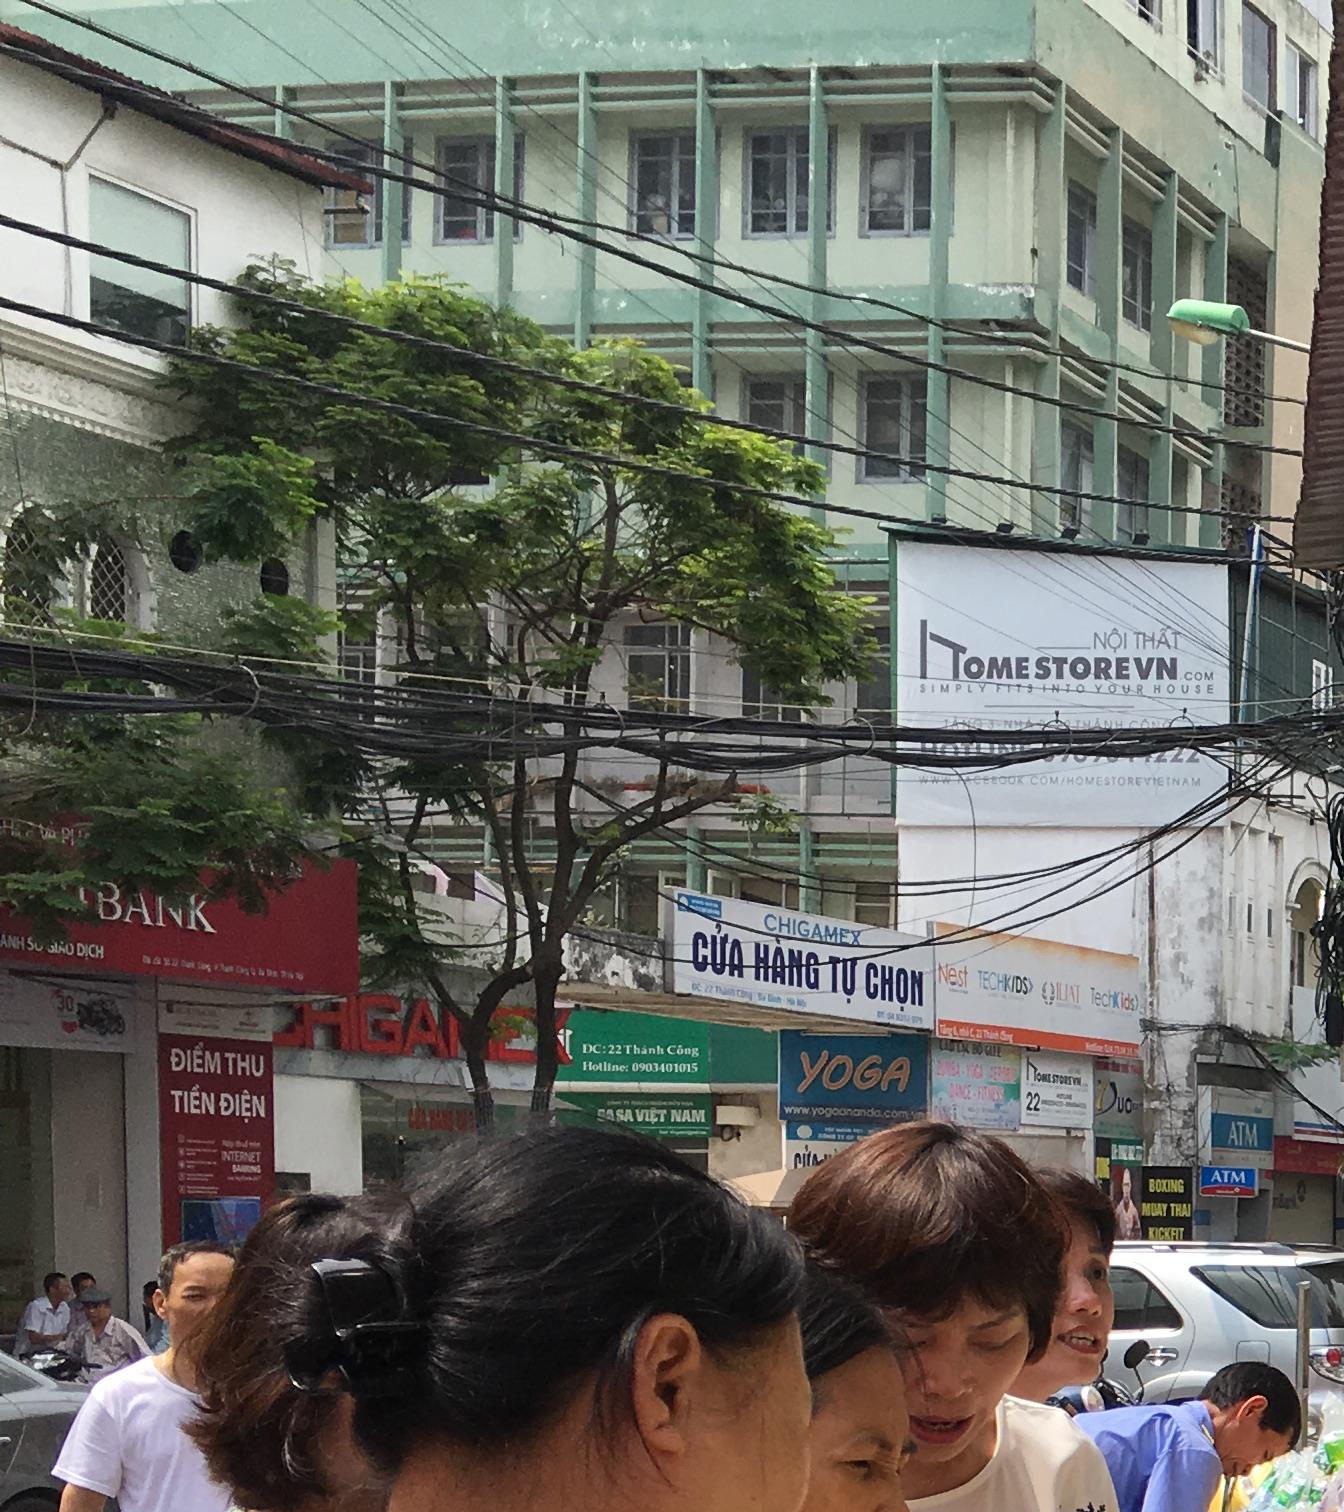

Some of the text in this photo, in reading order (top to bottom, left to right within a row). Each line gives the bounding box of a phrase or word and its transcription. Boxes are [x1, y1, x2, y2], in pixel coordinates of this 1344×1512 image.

[1093, 627, 1129, 653] NỘI
[920, 683, 986, 694] SIMPLY
[1094, 684, 1144, 695] YOUR
[1153, 683, 1215, 695] HOUSE
[764, 913, 861, 946] CHIGAMEX
[77, 942, 104, 959] DỊCH
[692, 923, 924, 1012] CỬA HÀNG TỰ CHỌN
[938, 962, 968, 988] Nest
[170, 1042, 264, 1077] ĐIỂM THU
[797, 1050, 911, 1093] YOGA
[171, 1084, 266, 1123] TIỀN ĐIỆN
[1026, 1091, 1040, 1112] 22
[671, 1110, 706, 1122] NAM
[1228, 1120, 1258, 1148] ATM
[221, 1151, 261, 1163] INTERNET
[1149, 1178, 1184, 1193] BOXING
[1210, 1169, 1246, 1184] ATM
[1142, 1203, 1191, 1217] MUAY THAI
[1148, 1227, 1185, 1241] KICKFIT
